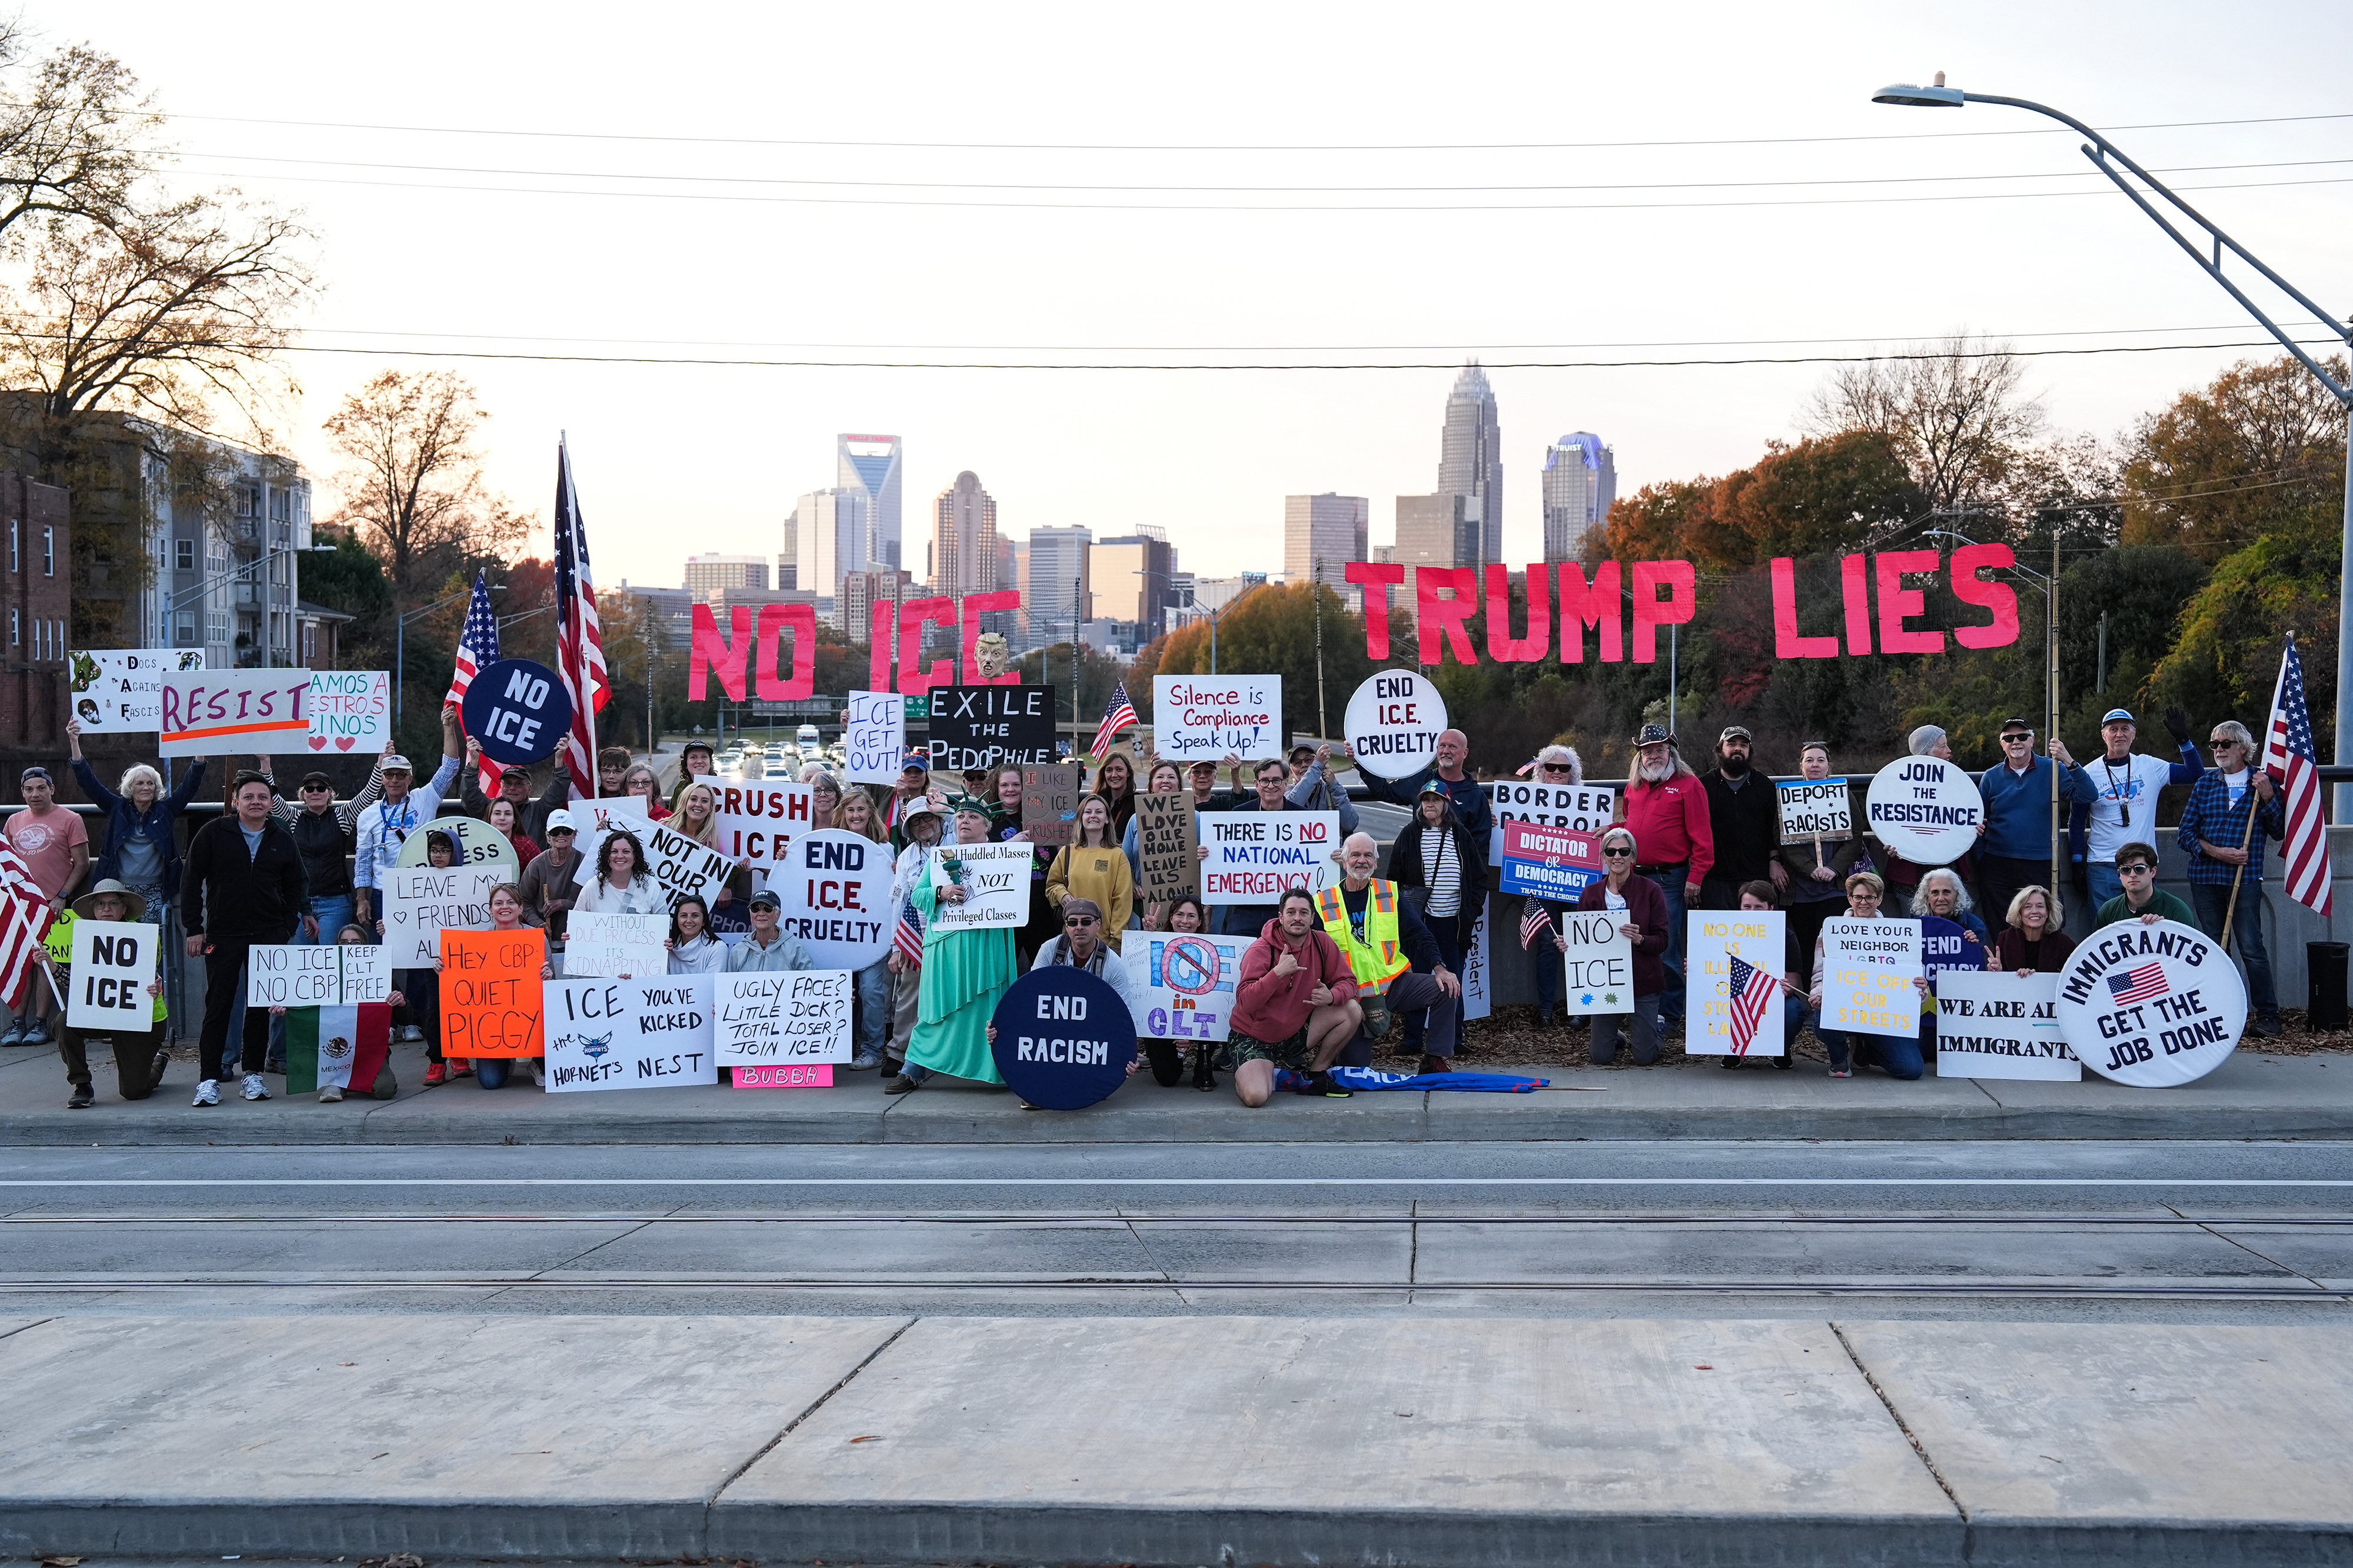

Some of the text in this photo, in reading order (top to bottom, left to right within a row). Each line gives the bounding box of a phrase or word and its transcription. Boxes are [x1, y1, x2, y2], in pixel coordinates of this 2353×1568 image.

[1771, 542, 2021, 659] LIES
[1345, 559, 1695, 665] TRUMP
[688, 590, 1021, 702] NO ICE
[121, 678, 160, 692] AGAINS
[309, 672, 388, 696] AMOS A
[504, 669, 550, 710] NO
[1169, 684, 1263, 706] Silence is
[1377, 677, 1412, 698] END
[121, 703, 159, 718] FASCIS
[162, 682, 310, 732] RESIST
[309, 695, 385, 715] ESTROS
[850, 696, 899, 726] ICE
[931, 690, 1043, 719] EXILE
[1379, 703, 1421, 725] I.C.E.
[309, 713, 376, 735] CINOS
[485, 706, 542, 751] ICE
[969, 723, 1009, 736] THE
[1184, 708, 1270, 731] Compliance
[855, 729, 895, 752] GET
[1357, 732, 1438, 756] CRUELTY
[851, 746, 899, 772] OUT!
[1025, 772, 1067, 786] I LIKE
[1899, 763, 1945, 783] JOIN
[711, 786, 809, 821] CRUSH
[1026, 796, 1068, 810] MY ICE
[1143, 795, 1185, 813] WE
[1497, 785, 1611, 813] BORDER
[1780, 785, 1845, 805] DEPORT
[1914, 788, 1936, 799] THE
[1141, 814, 1187, 831] LOVE
[1871, 803, 1978, 826] RESISTANCE
[1145, 828, 1186, 843] OUR
[1213, 822, 1327, 842] THERE IS NO
[649, 828, 700, 863] NOT
[701, 853, 732, 883] IN
[806, 841, 865, 871] END
[934, 851, 938, 863] I
[961, 846, 996, 862] Huddled
[998, 846, 1031, 859] Masses
[1144, 840, 1186, 855] HOME
[1224, 846, 1320, 865] NATIONAL
[1519, 832, 1588, 858] DICTATOR
[1143, 855, 1187, 872] LEAVE
[1545, 855, 1561, 868] OR
[397, 873, 501, 899] LEAVE MY
[656, 860, 707, 896] OUR
[976, 873, 1014, 888] NOT
[1150, 869, 1180, 886] US
[1515, 864, 1588, 888] DEMOCRACY
[808, 879, 866, 913] I.C.E.
[1521, 887, 1579, 902] THAT'S THE CHOICE
[417, 902, 491, 930] FRIENDS
[594, 916, 648, 930] WITHOUT
[942, 908, 1017, 925] Privileged Classes
[576, 926, 656, 946] DUE PROCESS
[785, 917, 882, 944] CRUELTY
[1572, 918, 1614, 945] NO
[1704, 923, 1767, 938] NO ONE
[1831, 925, 1913, 937] LOVE YOUR
[92, 935, 138, 968] NO
[346, 945, 378, 959] KEEP
[416, 939, 439, 961] AL
[448, 942, 488, 970] HEY
[605, 948, 624, 959] IT'S
[1725, 942, 1741, 955] IS
[1839, 940, 1909, 952] NEIGHBOR
[1922, 936, 1961, 955] FEND
[255, 948, 336, 972] NO ICE
[346, 960, 375, 976] CLT
[564, 956, 662, 976] KIDNAPPING
[1151, 941, 1236, 993] ICE
[1469, 920, 1484, 1000] President
[2061, 929, 2208, 1006] IMMIGRANTS
[1569, 958, 1626, 989] ICE
[1837, 969, 1911, 992] ICE OFF
[85, 977, 139, 1010] ICE
[255, 974, 338, 1003] NO CBP
[345, 978, 386, 1000] FREE
[454, 979, 521, 1006] QUIET
[734, 973, 847, 999] UGLY FACE?
[565, 985, 695, 1021] ICE YOU'VE
[1036, 995, 1087, 1020] END
[1173, 993, 1196, 1010] in
[1852, 991, 1887, 1007] OUR
[1938, 998, 2057, 1018] WE ARE AL
[639, 1012, 702, 1034] KICKED
[1148, 1007, 1216, 1037] CLT
[1838, 1007, 1911, 1029] STREETS
[2097, 989, 2207, 1039] GET THE
[448, 1009, 539, 1051] PIGGY
[728, 1019, 847, 1039] TOTAL LOSER?
[552, 1033, 576, 1052] the
[584, 1046, 608, 1054] HORNETS
[725, 1035, 837, 1056] JOIN ICE!!
[1017, 1036, 1108, 1065] RACISM
[2106, 1016, 2229, 1072] JOB DONE
[321, 1063, 351, 1074] MEXICO
[553, 1053, 704, 1087] HORNET'S NEST
[739, 1065, 819, 1085] BUBBA
